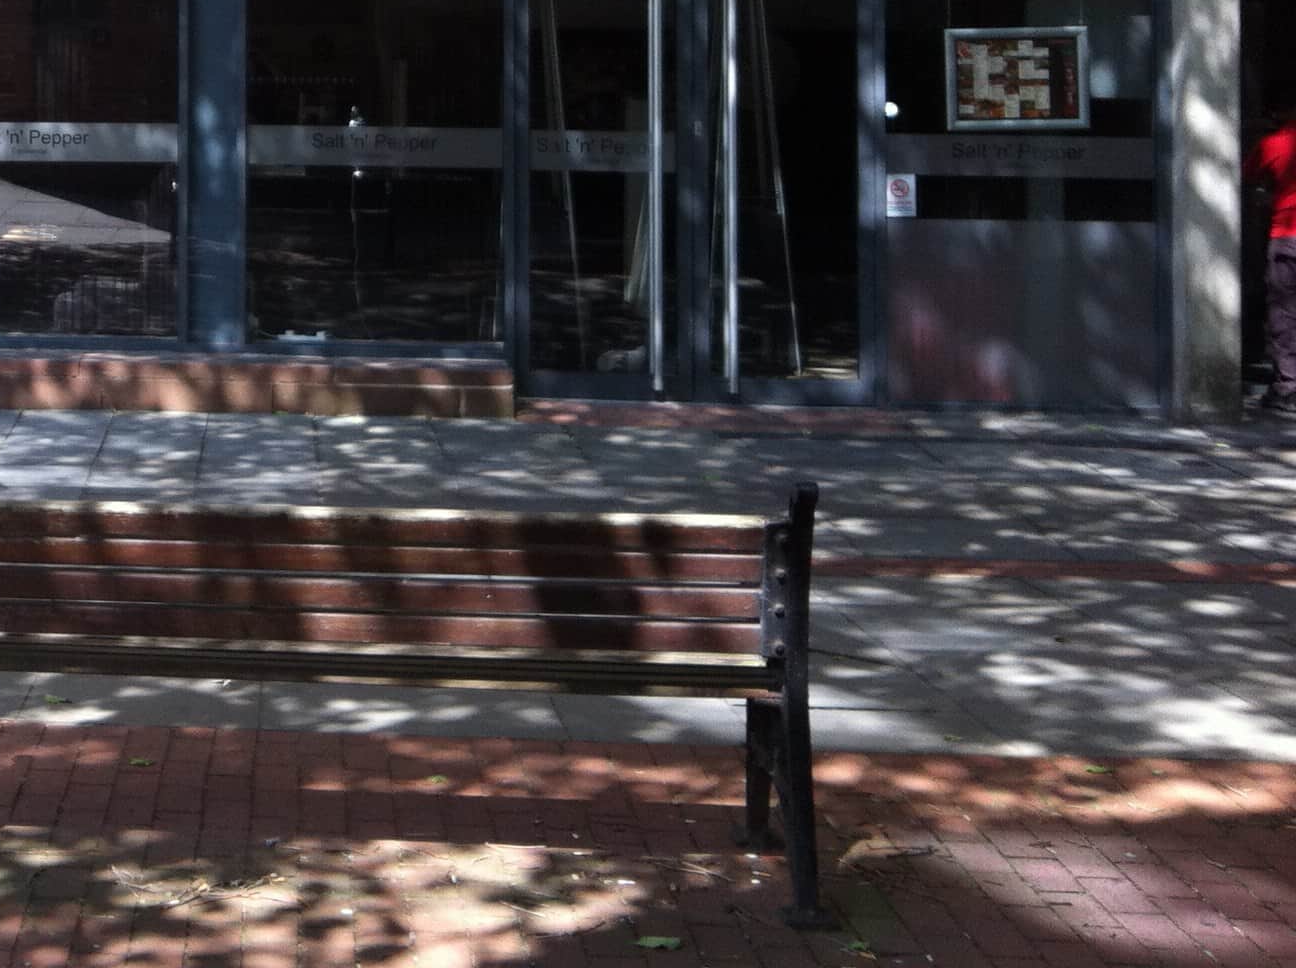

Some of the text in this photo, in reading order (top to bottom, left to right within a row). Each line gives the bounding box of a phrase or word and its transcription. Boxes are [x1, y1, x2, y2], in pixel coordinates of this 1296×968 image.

[6, 129, 24, 144] 'n'
[29, 129, 89, 148] Pepper
[311, 133, 344, 149] Salt
[375, 134, 439, 153] Pepper
[952, 143, 987, 159] Salt
